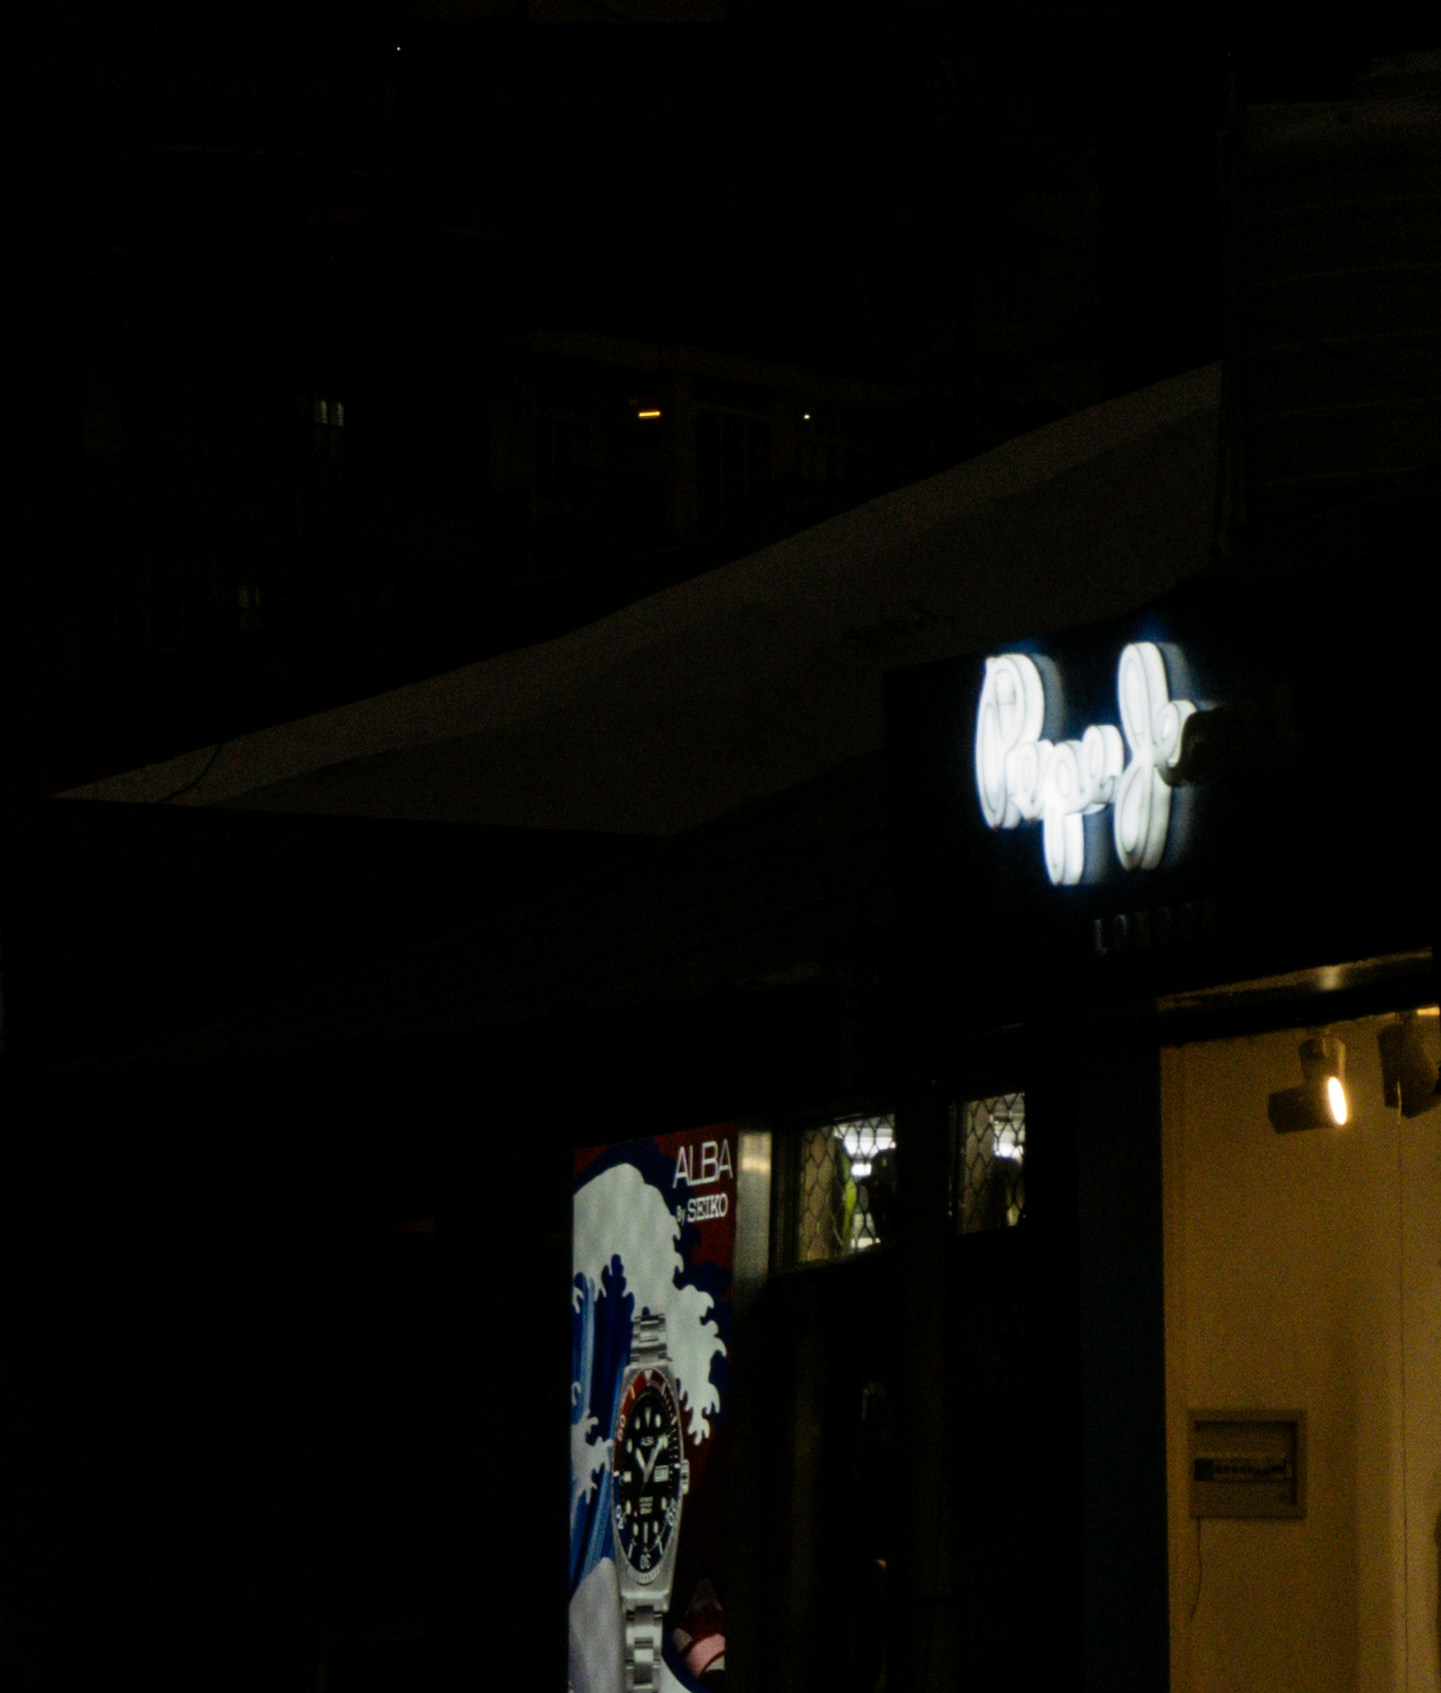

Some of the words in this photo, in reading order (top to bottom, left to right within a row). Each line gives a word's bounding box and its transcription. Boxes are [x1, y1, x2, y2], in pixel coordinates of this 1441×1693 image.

[975, 652, 1124, 886] Pepe
[672, 1138, 734, 1189] ALBA
[687, 1193, 729, 1223] SEIKO
